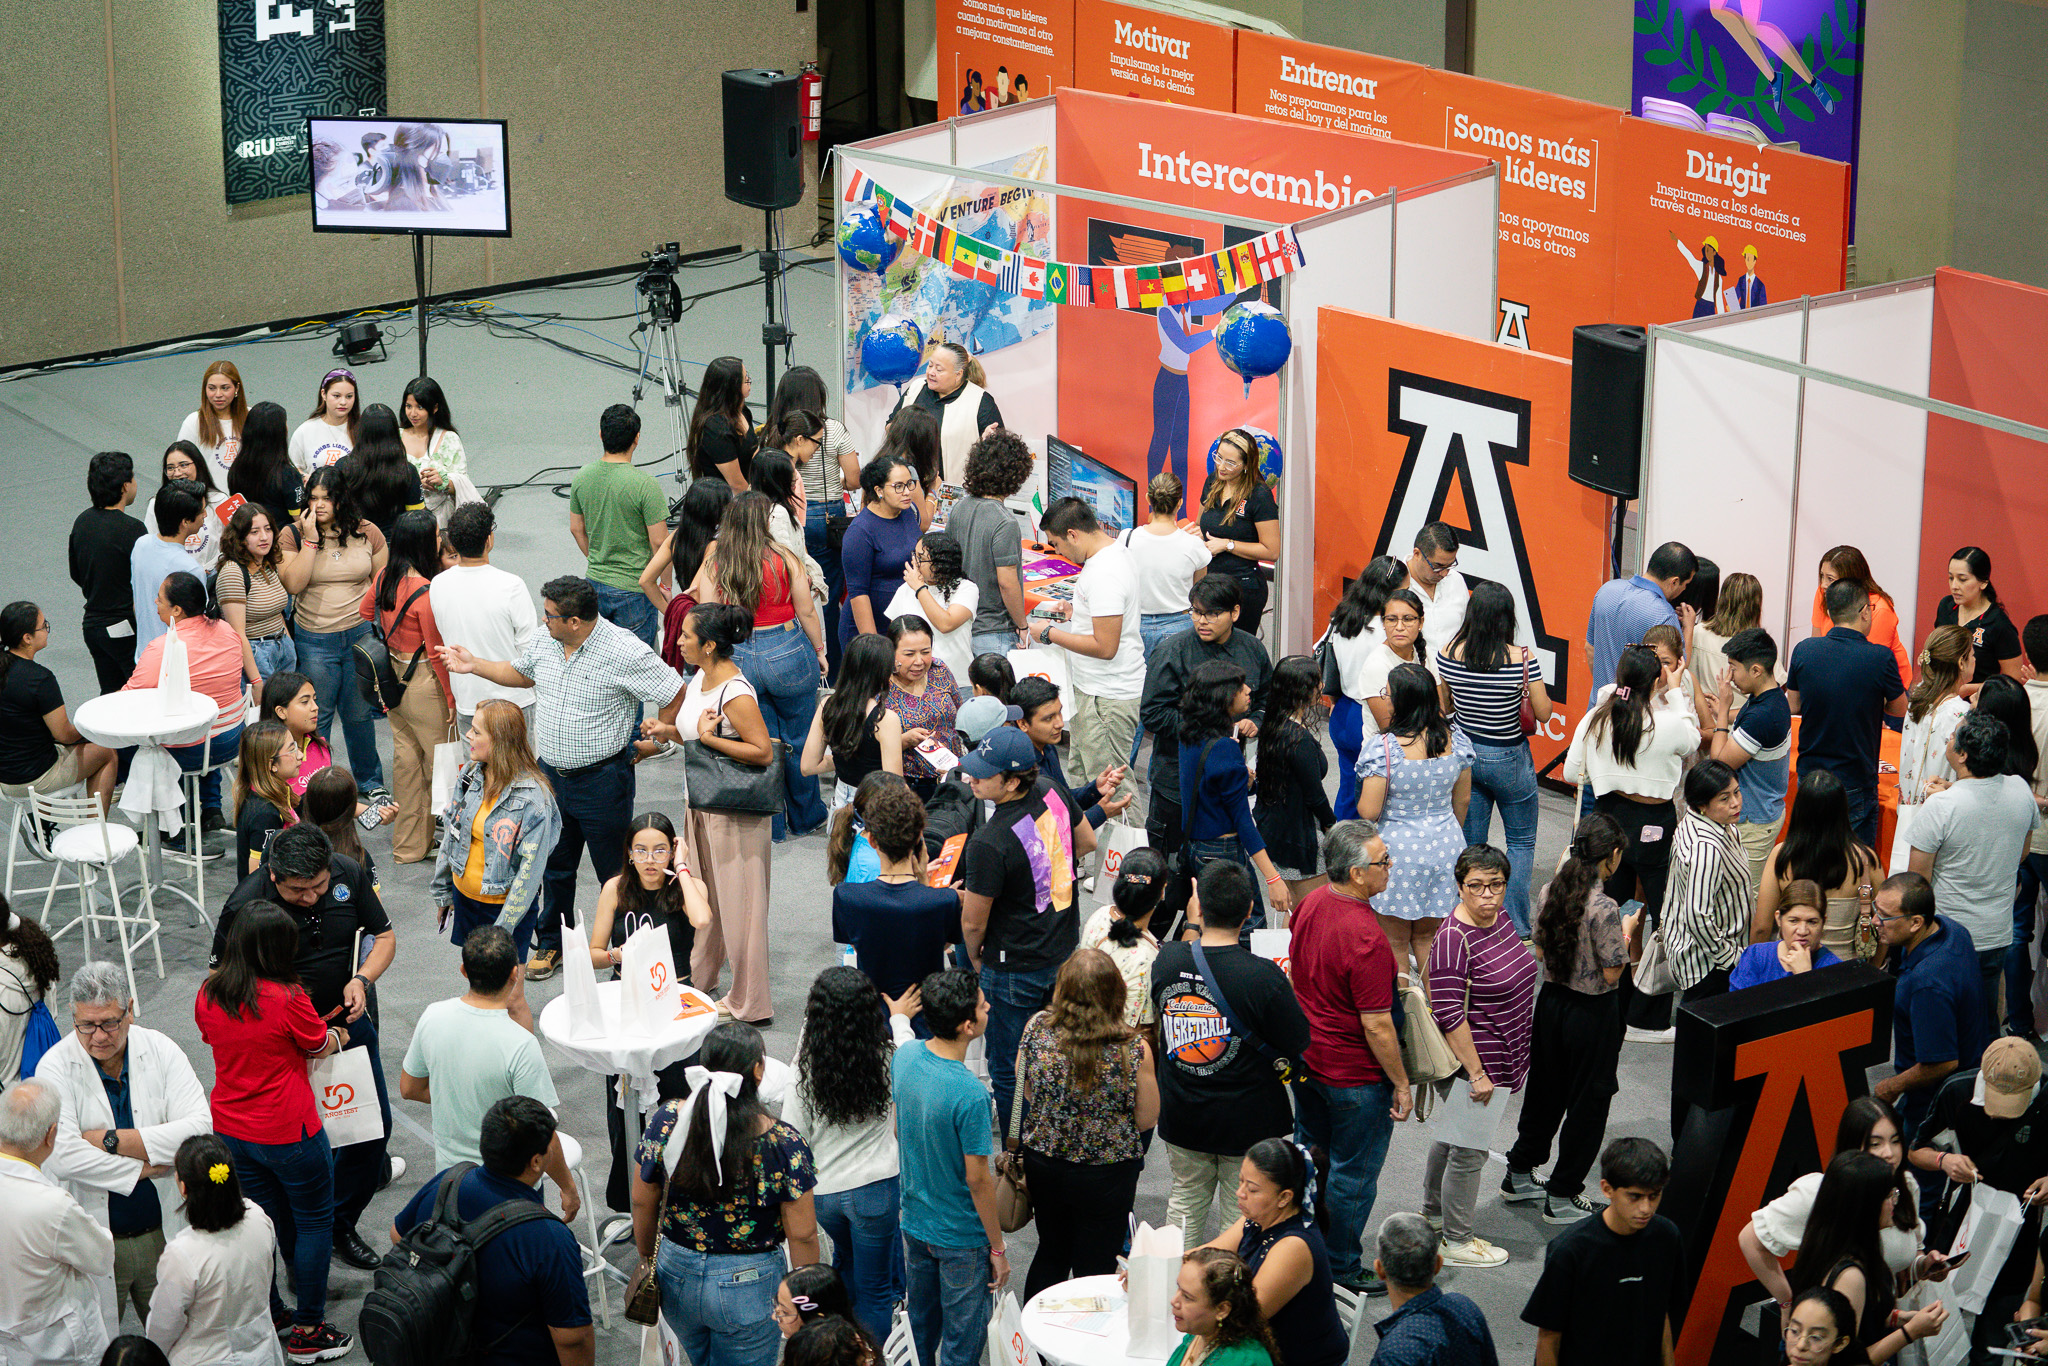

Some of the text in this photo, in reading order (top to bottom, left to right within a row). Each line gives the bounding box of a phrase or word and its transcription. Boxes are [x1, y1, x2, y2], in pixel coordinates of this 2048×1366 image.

[957, 11, 1053, 42] cuando motivamos al otro
[962, 0, 1048, 25] Somos más que líderes
[956, 25, 1055, 57] a mejorar constantemente.
[1114, 19, 1191, 60] Motivar
[1110, 51, 1195, 83] Impulsamos la mejor
[1110, 67, 1195, 96] versión de los demás
[1280, 55, 1378, 100] Entrenar
[1265, 103, 1392, 140] retos del hoy y del mañana
[1269, 88, 1388, 124] Nos preparamos para los
[1453, 113, 1591, 168] Somos más
[1505, 155, 1586, 200] líderes
[1686, 149, 1771, 198] Dirigir
[1649, 194, 1806, 243] través de nuestras acciones
[1656, 181, 1800, 227] Inspiramos a los demás a
[1511, 232, 1521, 245] a
[1522, 232, 1541, 250] los
[1543, 239, 1576, 259] otros
[1521, 217, 1590, 244] apoyamos
[650, 962, 667, 992] 50
[1166, 999, 1217, 1015] California
[321, 1083, 355, 1110] 50
